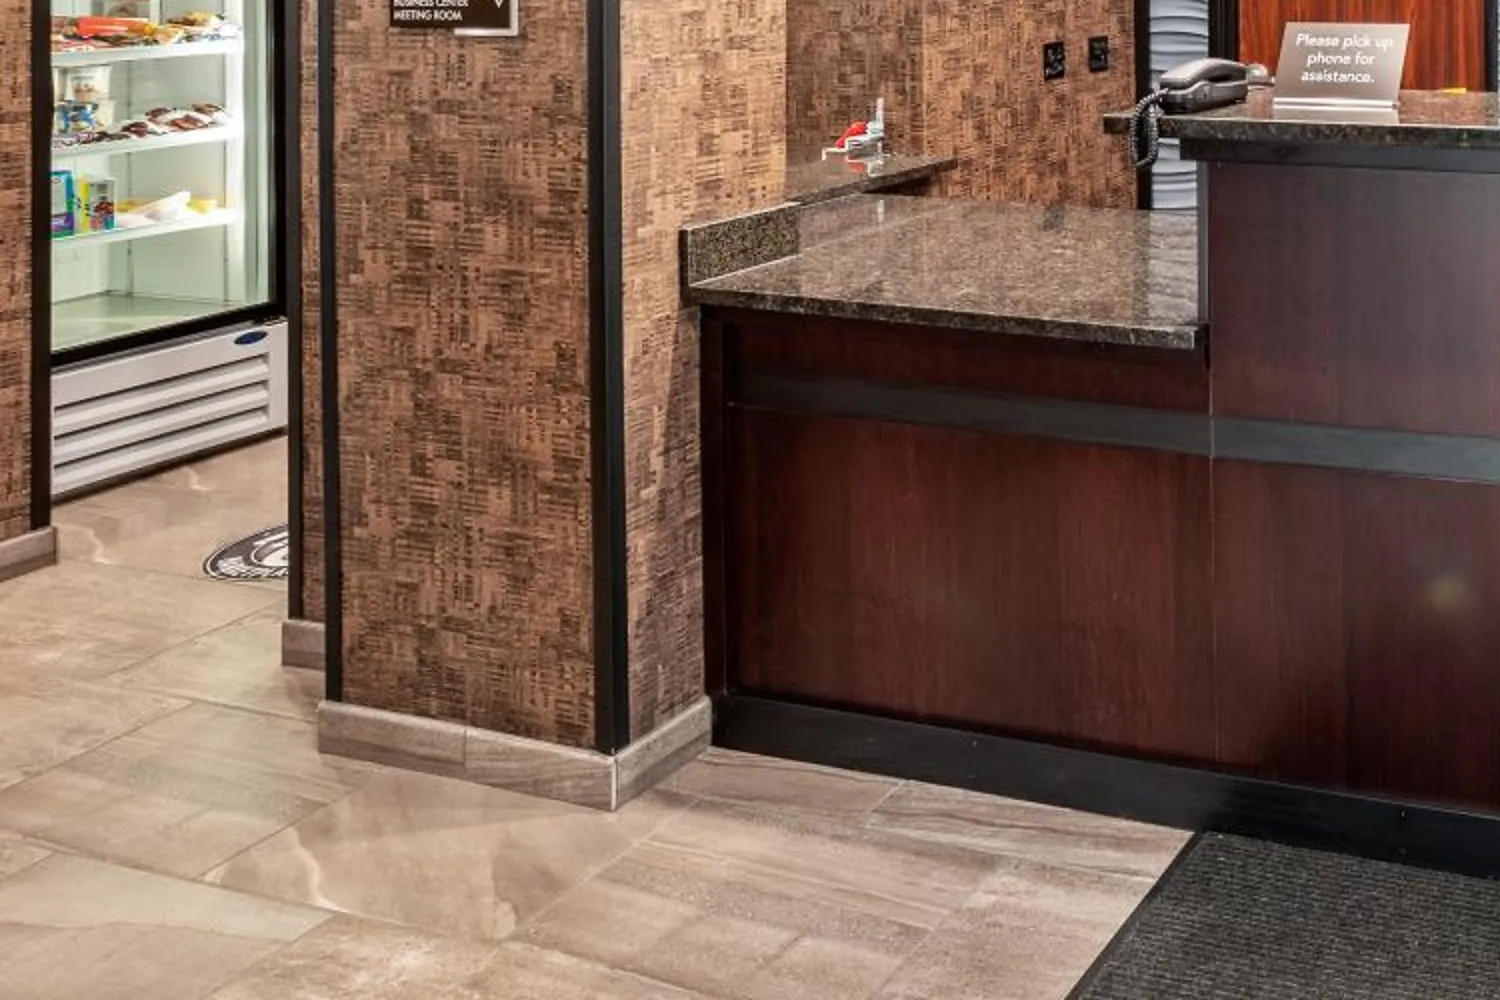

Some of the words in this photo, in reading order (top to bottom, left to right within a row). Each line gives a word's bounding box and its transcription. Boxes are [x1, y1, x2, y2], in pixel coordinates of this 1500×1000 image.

[393, 9, 433, 21] MEETING
[433, 9, 463, 21] ROOM
[1295, 33, 1340, 46] Please
[1341, 34, 1371, 51] pick
[1375, 38, 1393, 51] up
[1306, 51, 1352, 68] phone
[1355, 50, 1375, 65] for
[1301, 68, 1376, 83] assistance.
